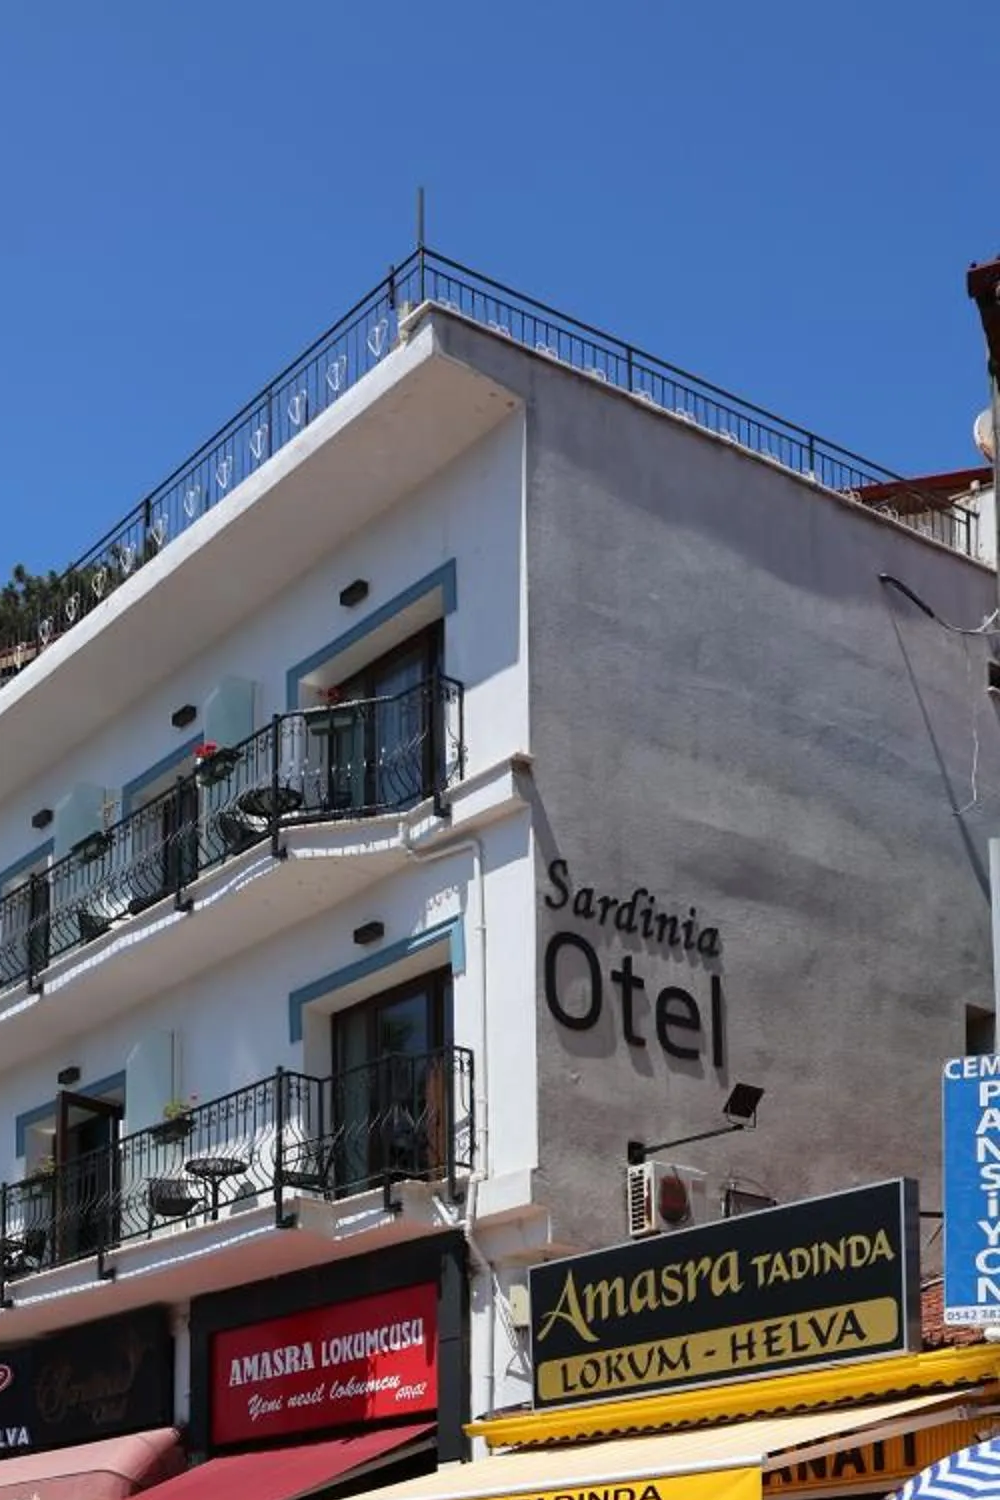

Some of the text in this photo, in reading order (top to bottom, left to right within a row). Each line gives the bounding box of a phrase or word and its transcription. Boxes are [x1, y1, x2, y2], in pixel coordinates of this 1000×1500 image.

[545, 859, 719, 957] Sardinia
[545, 931, 722, 1067] Otel
[537, 1228, 895, 1343] Amasra TADINDA
[229, 1341, 315, 1387] AMASRA
[730, 1309, 867, 1363] HELVA
[248, 1374, 401, 1421] Yeni nesil lokumcu
